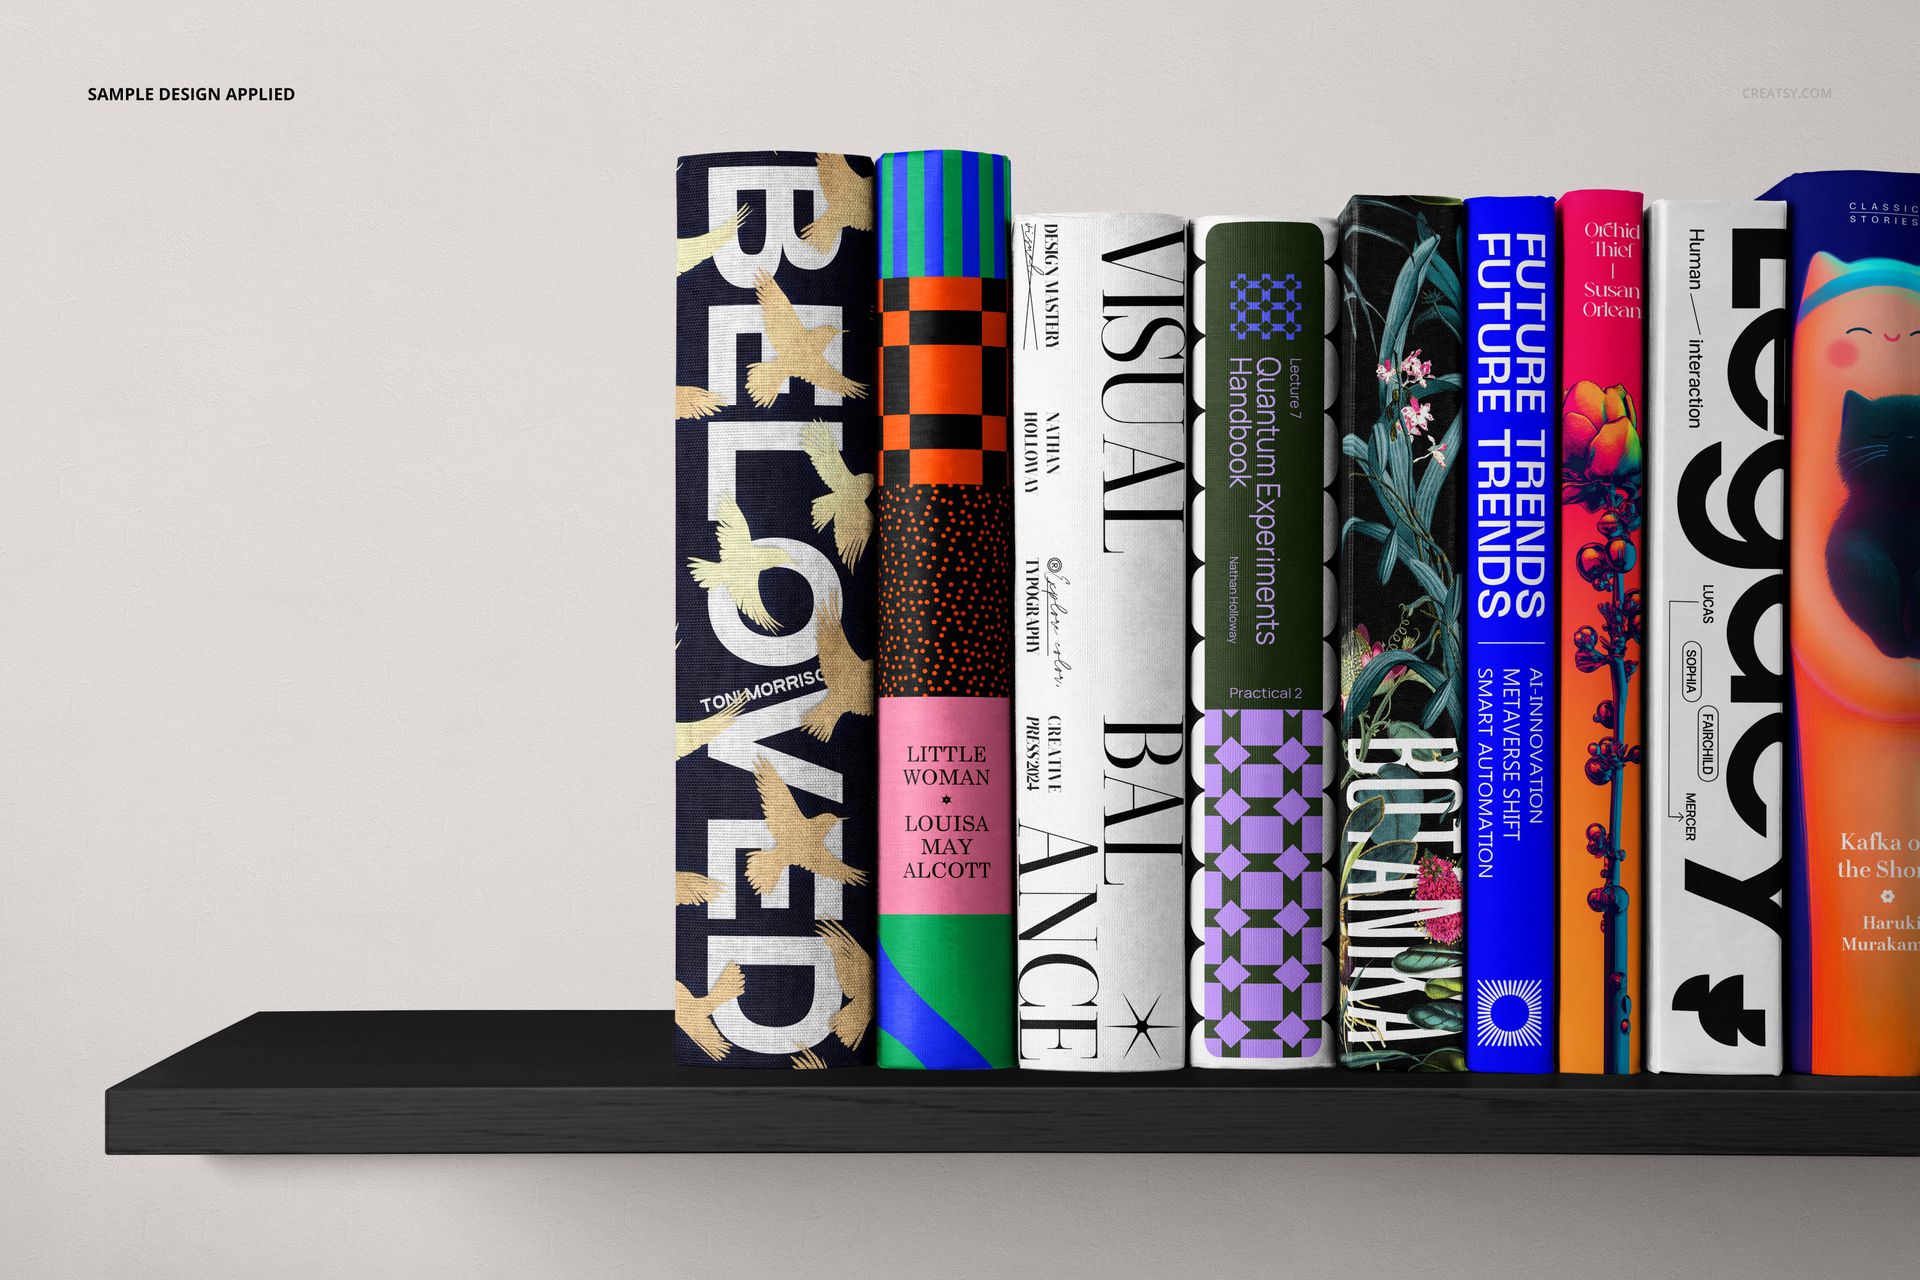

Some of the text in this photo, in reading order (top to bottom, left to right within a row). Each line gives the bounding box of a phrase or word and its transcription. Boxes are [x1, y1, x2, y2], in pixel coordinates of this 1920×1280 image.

[1584, 221, 1640, 240] Orchid
[1849, 202, 1919, 214] CLASSIC
[1849, 215, 1919, 227] STORIES
[1590, 241, 1635, 259] Thief
[1043, 223, 1060, 351] DESIGN MASTERY
[1582, 301, 1642, 319] Orlean
[1583, 280, 1640, 299] Susan
[1688, 228, 1705, 429] Human interaction
[1100, 223, 1187, 554] VISUAL
[1289, 357, 1303, 419] Lecture 7
[1023, 411, 1039, 496] HOLLOWAY
[1046, 411, 1060, 475] NATHAN
[1229, 357, 1253, 489] Handbook
[1477, 233, 1512, 618] FUTURE TRENDS
[1515, 233, 1546, 618] FUTURE TRENDS
[1248, 356, 1283, 646] Quantum Experiments
[706, 164, 843, 1055] BELOVED
[1025, 556, 1041, 656] TYPOGRAPHY
[1226, 556, 1239, 644] Nathan Holloway
[1702, 583, 1714, 624] LUCAS
[699, 689, 741, 712] TONI
[1229, 686, 1303, 699] Practical 2
[1685, 649, 1697, 694] SOPHIA
[907, 745, 987, 763] LITTLE
[1047, 714, 1062, 794] CREATIVE
[1477, 667, 1494, 879] SMART AUTOMATION
[1502, 668, 1521, 841] METAVERSE SHIFT
[1529, 667, 1543, 824] AI-INNOVATION
[1701, 713, 1714, 776] FAIRCHILD
[903, 768, 991, 786] WOMAN
[905, 814, 990, 832] LOUISA
[921, 838, 974, 856] MAY
[1685, 792, 1697, 842] MERCER
[1840, 831, 1902, 851] Kafka
[902, 862, 992, 880] ALCOTT
[1346, 737, 1464, 1043] BOTANIKA
[1837, 859, 1872, 878] the
